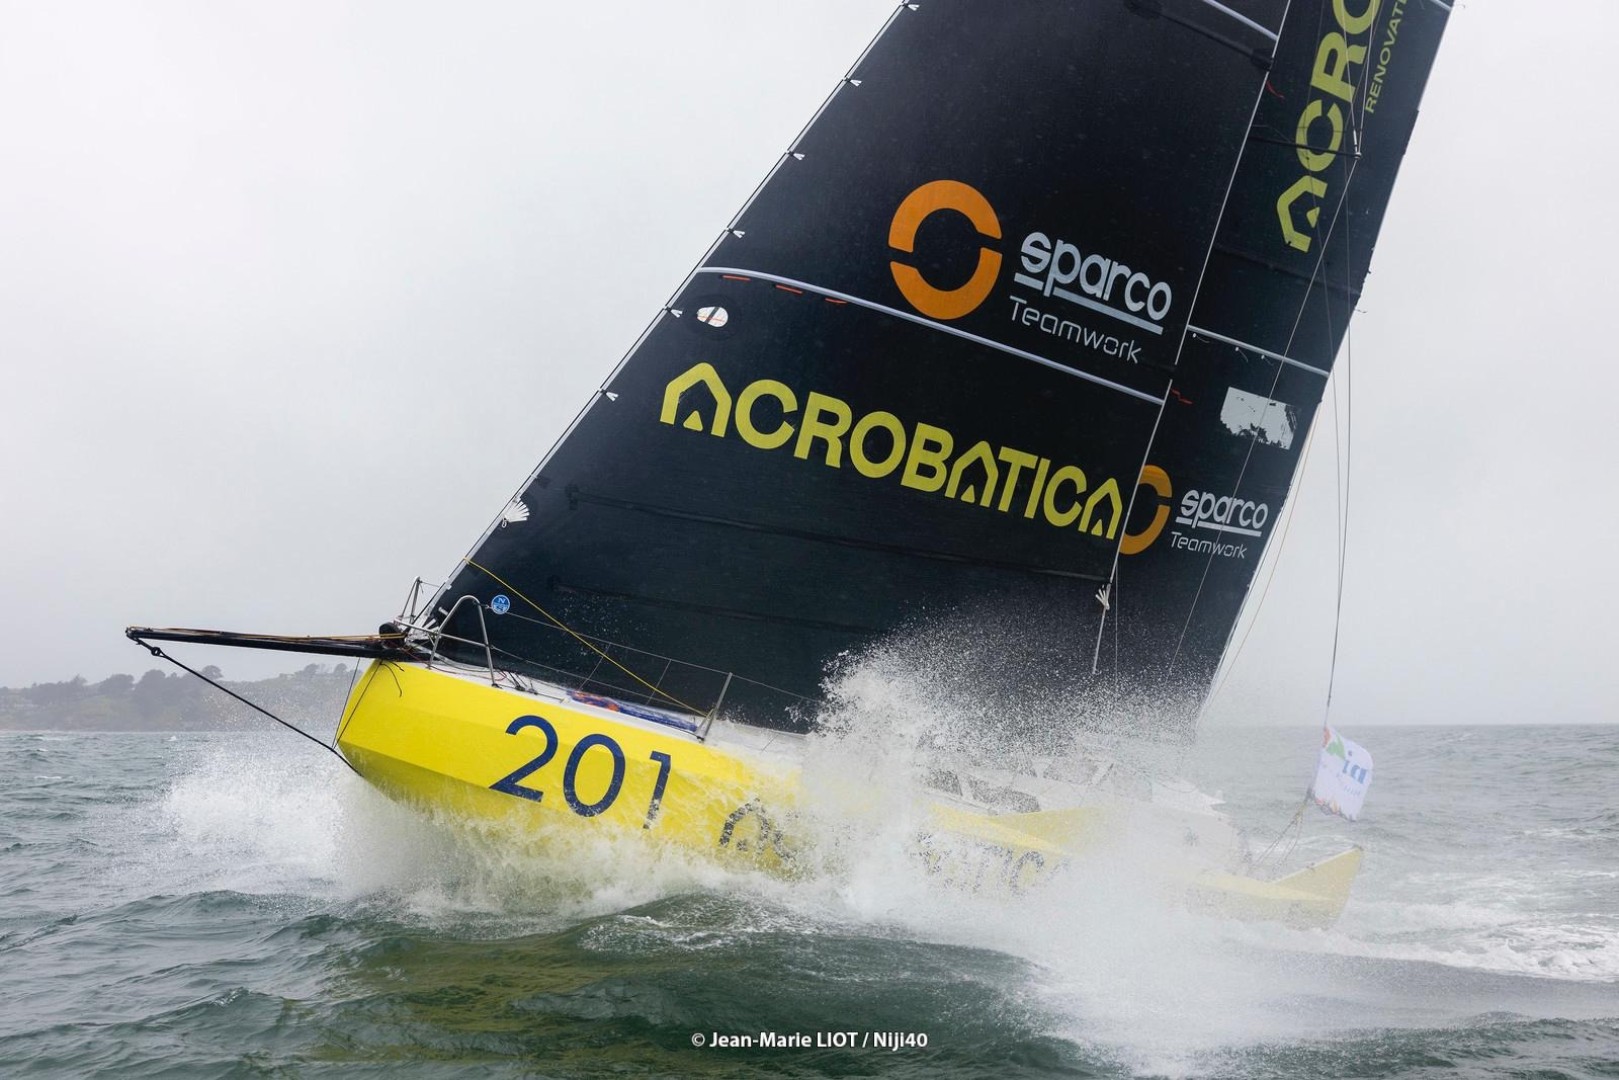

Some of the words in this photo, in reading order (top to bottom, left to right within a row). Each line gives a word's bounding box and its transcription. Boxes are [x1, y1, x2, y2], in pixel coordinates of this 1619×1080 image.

[1365, 0, 1406, 114] RENOVAT
[1020, 231, 1172, 321] sparco
[1009, 295, 1142, 364] Teamwork
[660, 362, 1123, 540] ACROBATICA
[1171, 531, 1248, 559] Teamwork
[1180, 489, 1269, 529] sparco
[489, 715, 672, 829] 201
